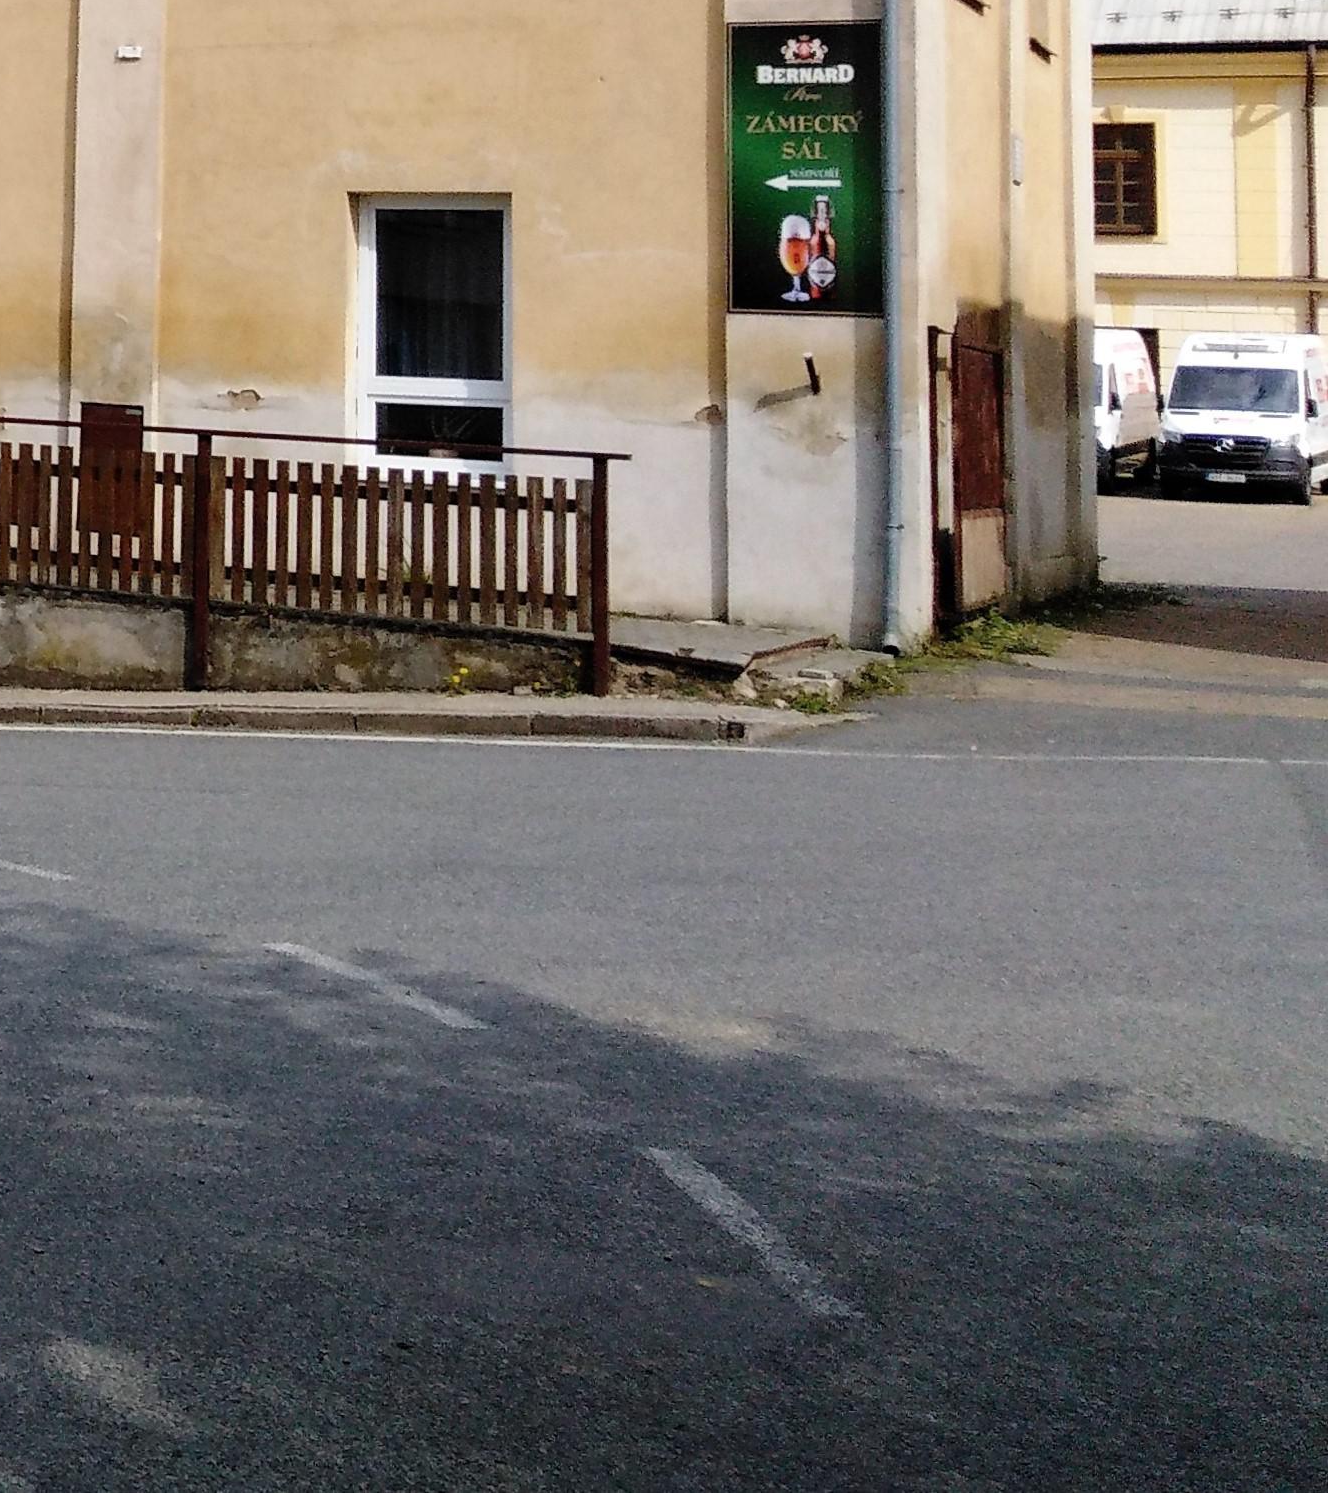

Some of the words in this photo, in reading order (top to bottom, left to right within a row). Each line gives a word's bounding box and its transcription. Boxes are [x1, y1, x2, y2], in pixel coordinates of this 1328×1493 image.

[756, 64, 855, 84] BERNARD
[746, 111, 863, 134] ZÁMECKÝ
[782, 137, 828, 160] SÁL
